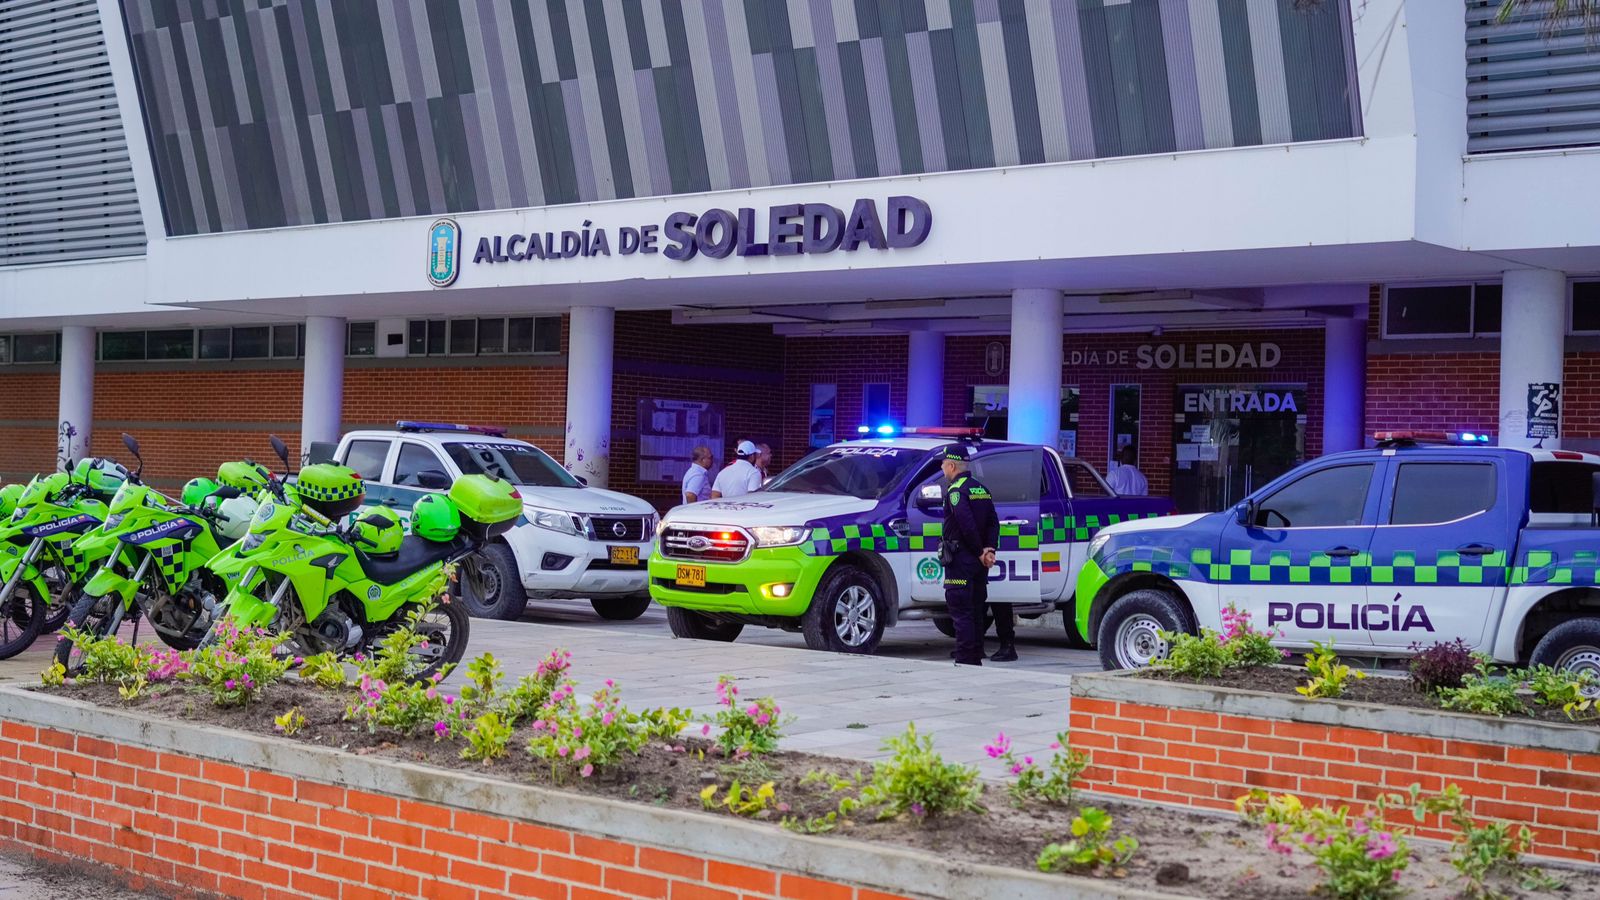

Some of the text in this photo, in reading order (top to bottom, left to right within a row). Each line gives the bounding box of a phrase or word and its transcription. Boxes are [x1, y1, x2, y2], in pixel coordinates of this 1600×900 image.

[473, 195, 933, 264] ALCALDÍA DE SOLEDAD
[1106, 350, 1129, 365] DE
[1136, 342, 1282, 370] SOLEDAD
[1184, 391, 1298, 413] ENTRADA
[38, 516, 78, 532] POLICÍA
[136, 522, 178, 539] POLICÍA
[1268, 592, 1435, 632] POLICÍA
